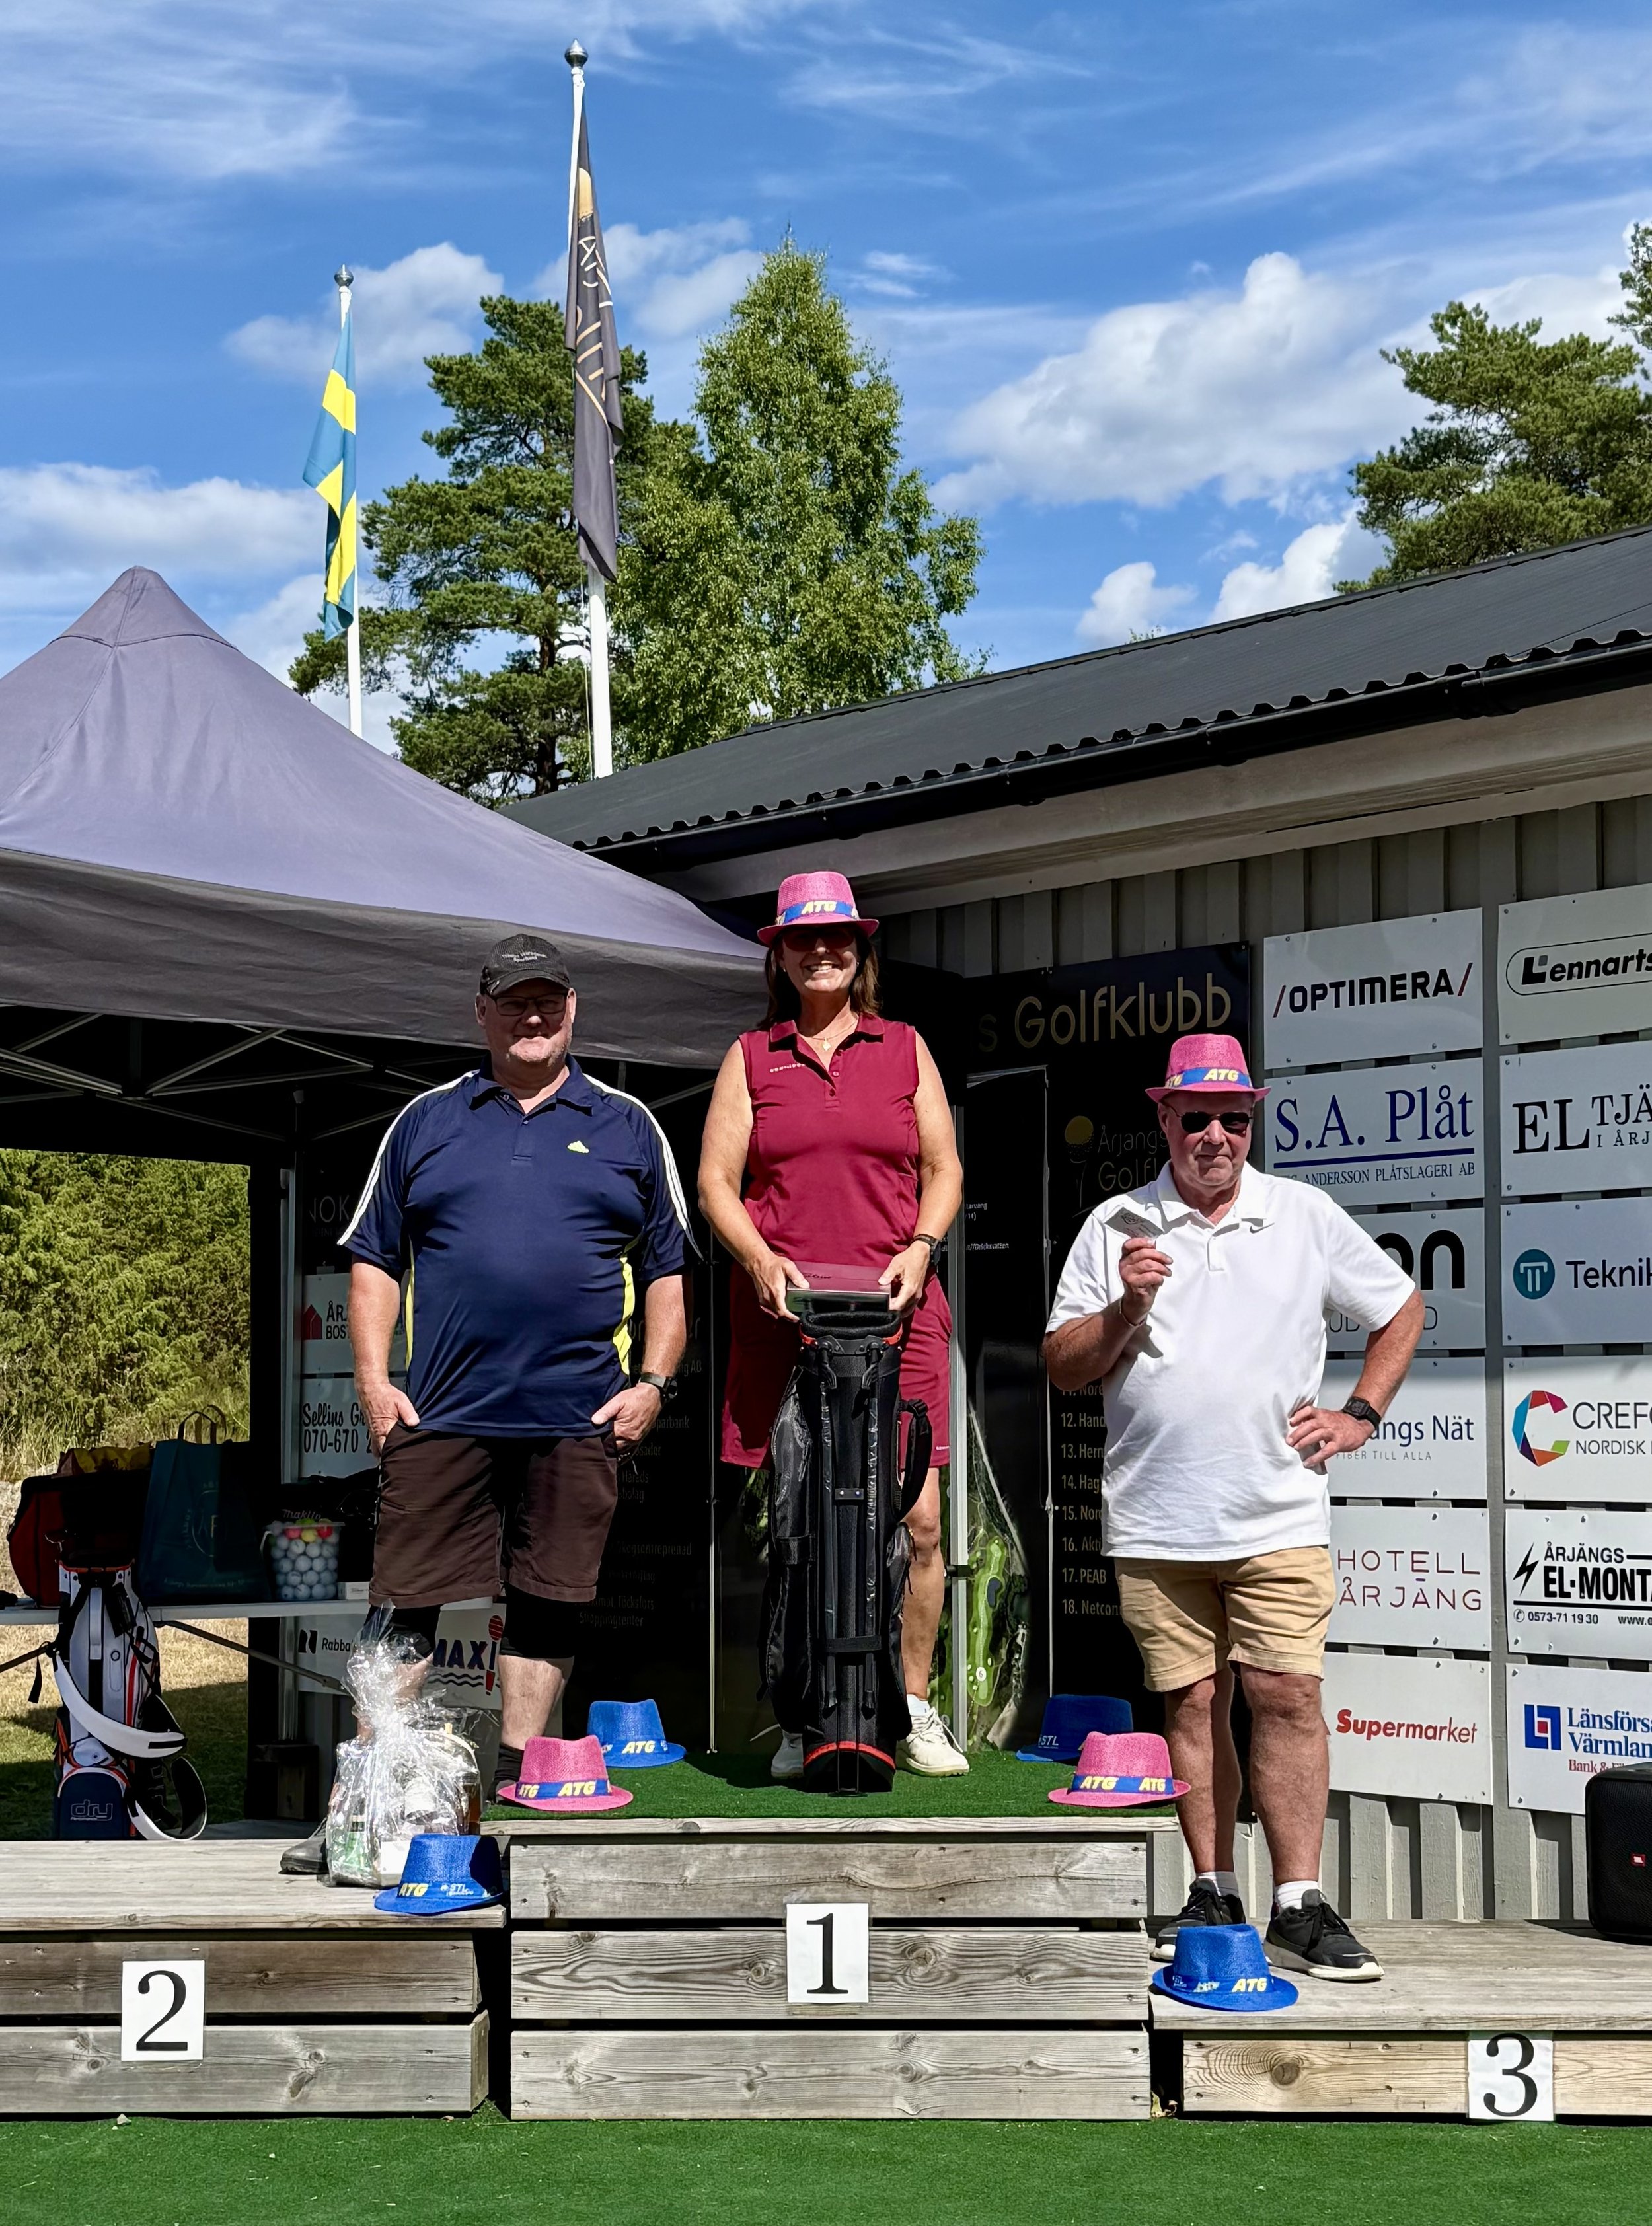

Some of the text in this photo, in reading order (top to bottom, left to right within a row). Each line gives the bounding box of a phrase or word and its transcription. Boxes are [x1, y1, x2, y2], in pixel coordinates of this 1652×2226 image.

[802, 901, 837, 915] ATG
[1014, 973, 1232, 1049] Golfklubb
[1203, 1069, 1240, 1082] ATG
[1276, 1084, 1475, 1153] S.A. Plåt
[1098, 1158, 1157, 1191] Golf
[1376, 1164, 1452, 1182] PLÅTSLAGERI
[1459, 1161, 1475, 1176] AB
[1061, 1412, 1077, 1428] 12.
[1573, 1402, 1652, 1429] CREF
[1433, 1415, 1474, 1441] Nät
[304, 1428, 359, 1454] 070-670
[1576, 1440, 1646, 1454] NORDISK
[1061, 1443, 1077, 1459] 13.
[1373, 1450, 1396, 1460] TILL
[1403, 1452, 1432, 1460] ALLA
[1061, 1474, 1078, 1490] 14.
[1061, 1505, 1078, 1521] 15.
[1061, 1536, 1078, 1553] 16.
[1544, 1541, 1624, 1563] ÅRJÄNGS
[1337, 1549, 1481, 1575] HOTELL
[1061, 1567, 1107, 1584] 17. PEAB
[1061, 1598, 1078, 1615] 18.
[1336, 1709, 1478, 1744] Supermarket
[1567, 1707, 1652, 1733] Länsförs
[622, 1740, 656, 1754] ATG
[1569, 1759, 1597, 1773] Bank
[558, 1781, 597, 1797] ATG
[1080, 1776, 1166, 1791] ATG ATG
[398, 1883, 429, 1897] ATG
[806, 1913, 849, 1994] 1
[1231, 1977, 1268, 1993] ATG
[136, 1970, 188, 2052] 2
[1483, 2032, 1538, 2117] 3
